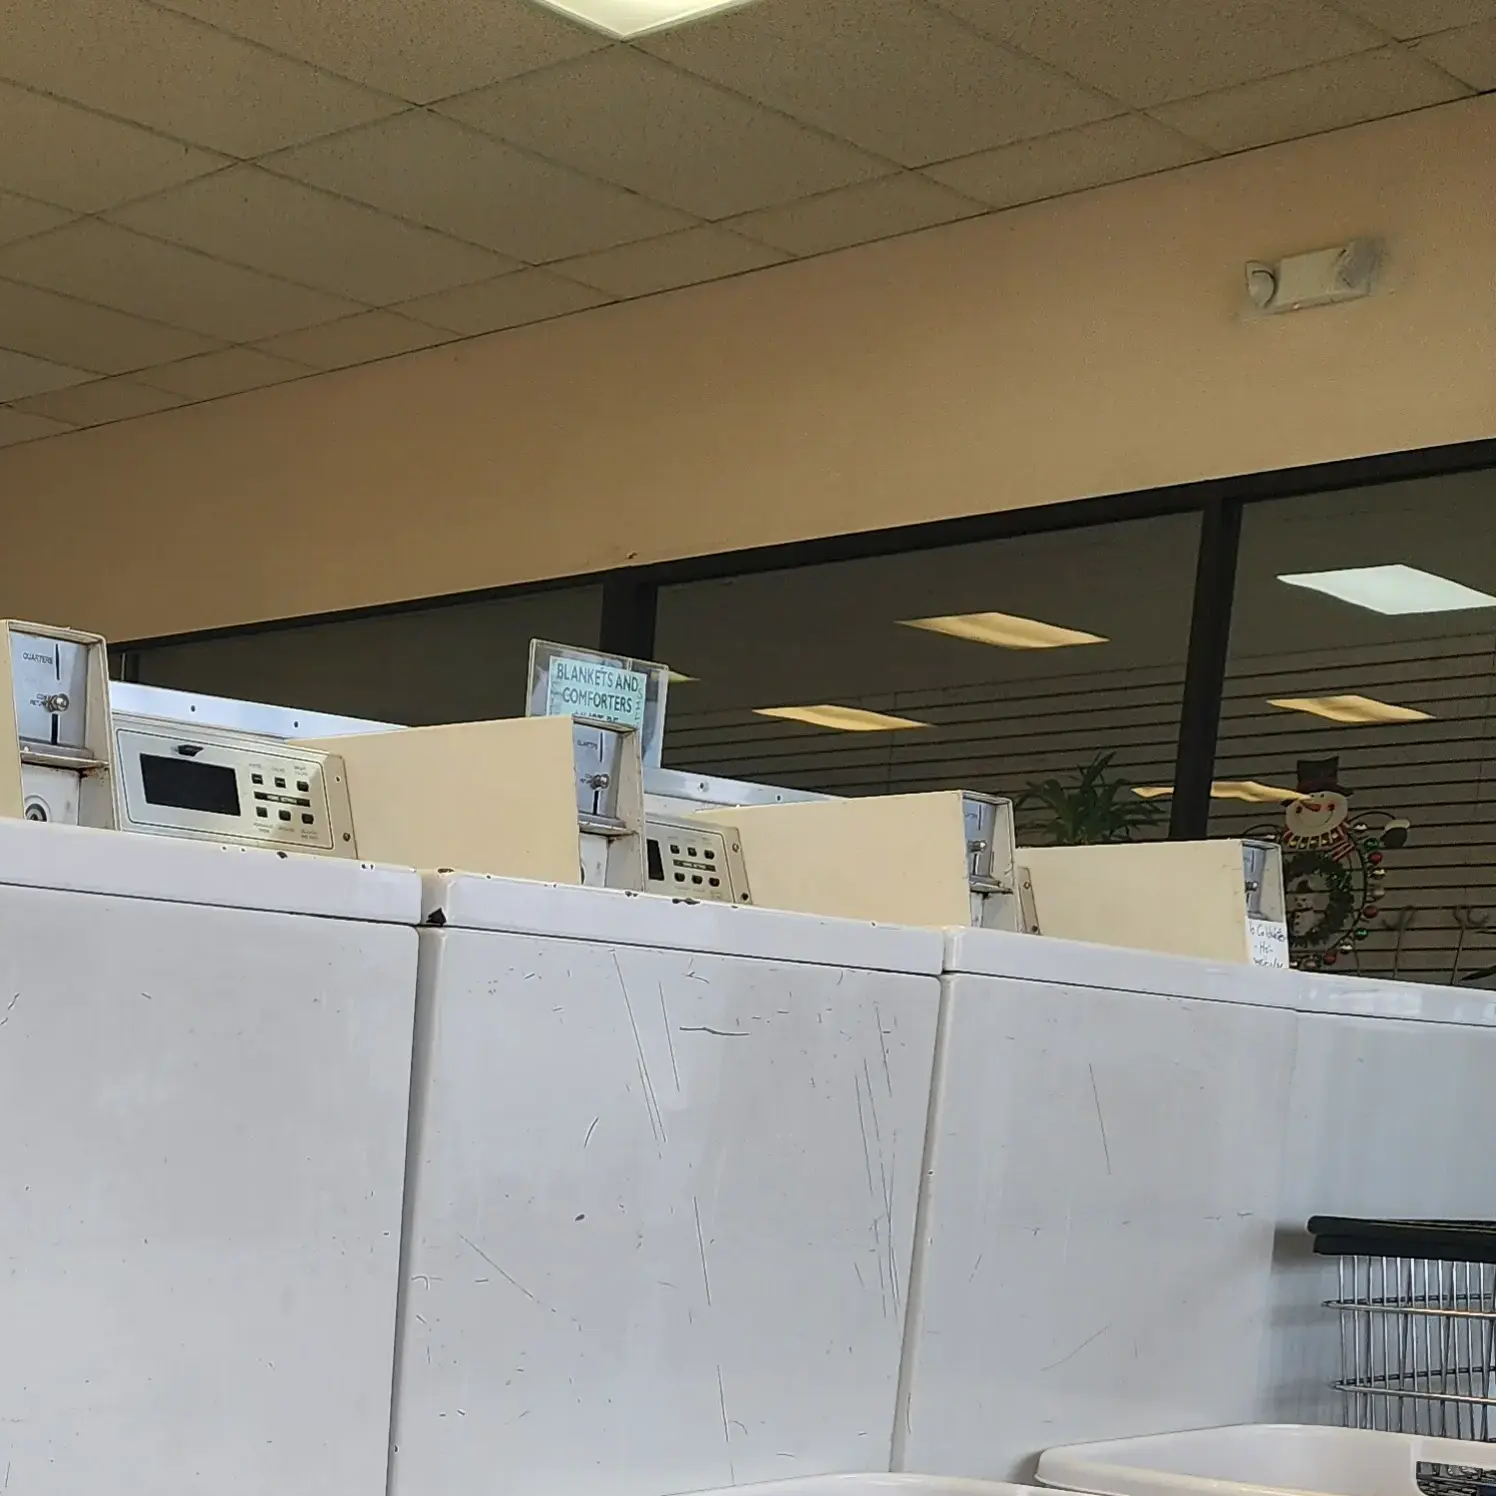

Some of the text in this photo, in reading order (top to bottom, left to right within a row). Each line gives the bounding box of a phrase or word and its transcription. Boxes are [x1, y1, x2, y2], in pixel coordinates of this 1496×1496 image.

[556, 663, 639, 693] BLANKETS AND
[562, 686, 633, 714] COMFORTERS
